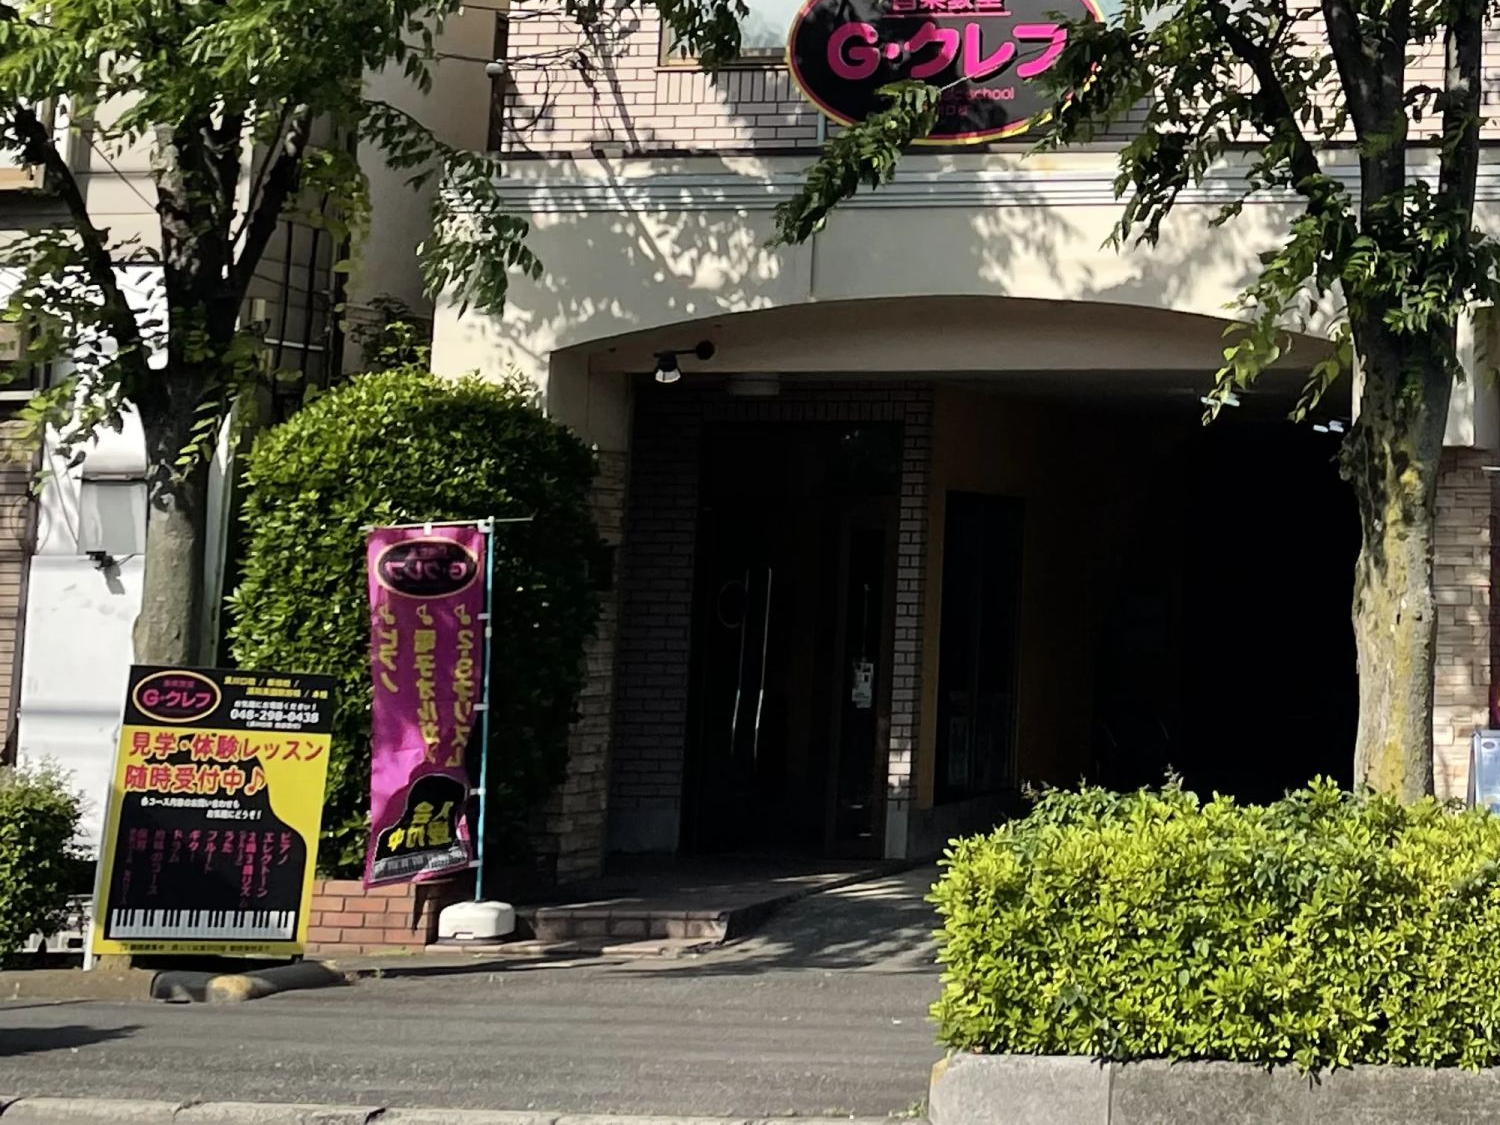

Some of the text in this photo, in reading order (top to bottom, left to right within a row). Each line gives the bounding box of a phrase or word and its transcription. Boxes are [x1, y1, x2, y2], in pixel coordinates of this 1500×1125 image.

[827, 22, 1068, 80] G・クレフ
[142, 689, 211, 709] G・クレフ
[230, 709, 319, 724] 048-298-0438
[128, 731, 324, 762] 見学・体験レッスン
[124, 764, 246, 794] 随時受付中
[278, 832, 292, 866] ピアノ
[256, 832, 275, 899] エレクトーン
